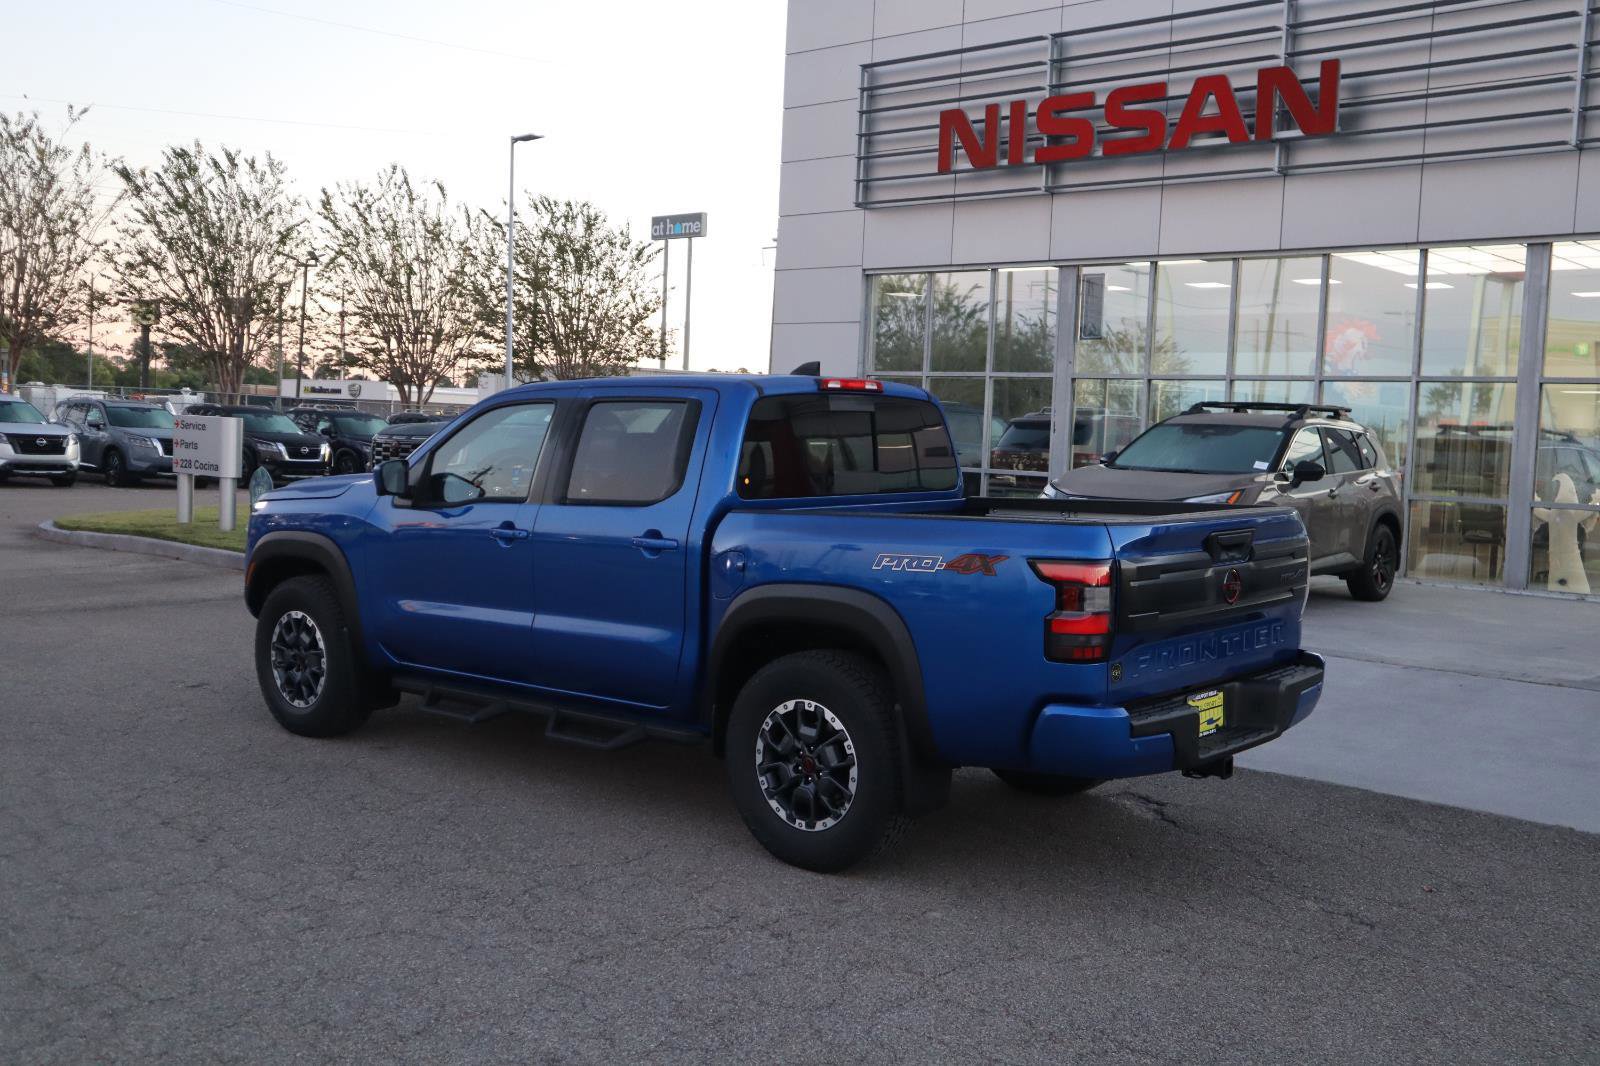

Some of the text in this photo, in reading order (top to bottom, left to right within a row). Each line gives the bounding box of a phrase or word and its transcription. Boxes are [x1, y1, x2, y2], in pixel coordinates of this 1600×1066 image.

[938, 58, 1341, 174] NISSAN
[652, 218, 701, 236] at home
[180, 419, 207, 431] Service
[180, 440, 199, 450] Parts
[180, 459, 219, 472] 228 Cocina
[1131, 623, 1286, 678] FRONTIER
